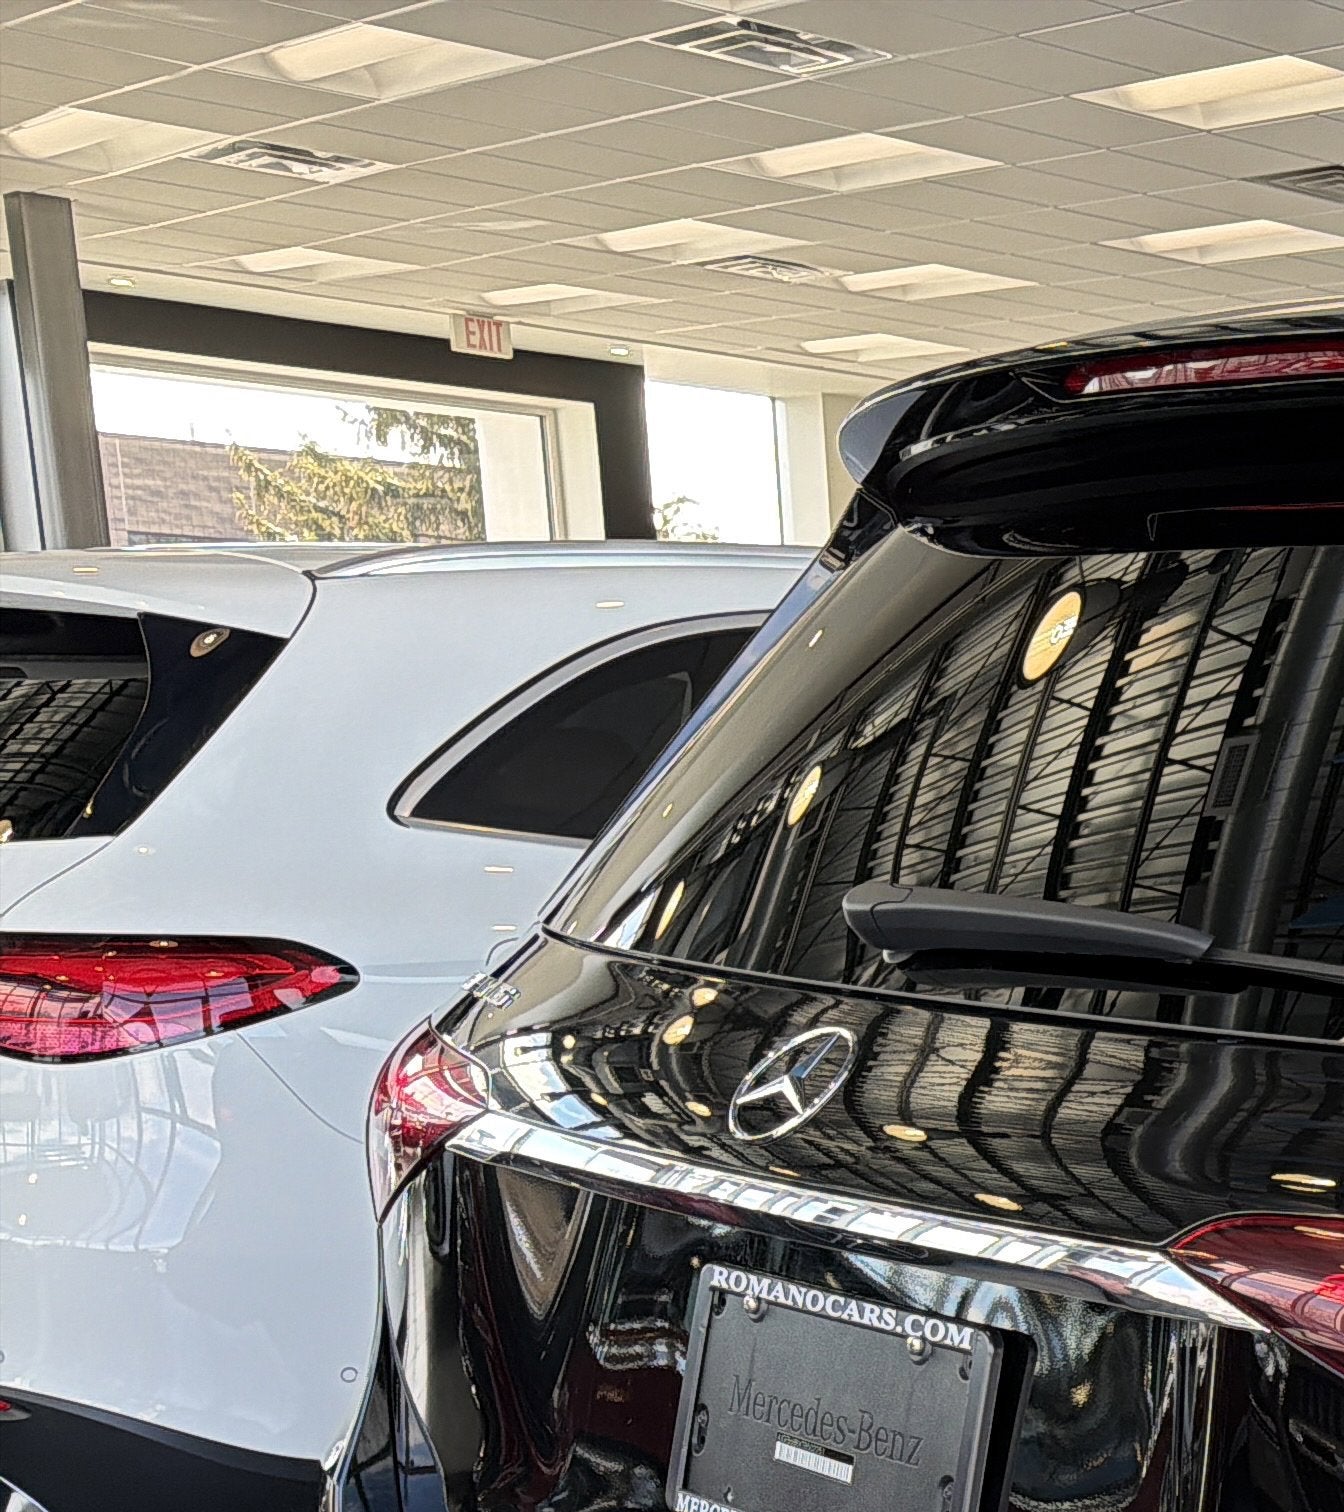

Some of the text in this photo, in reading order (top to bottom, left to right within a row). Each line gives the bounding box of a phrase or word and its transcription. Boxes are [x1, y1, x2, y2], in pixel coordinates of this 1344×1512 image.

[464, 317, 503, 354] EXIT
[710, 1266, 975, 1350] ROMANOCARS.COM
[727, 1374, 925, 1468] Mercedes-Benz
